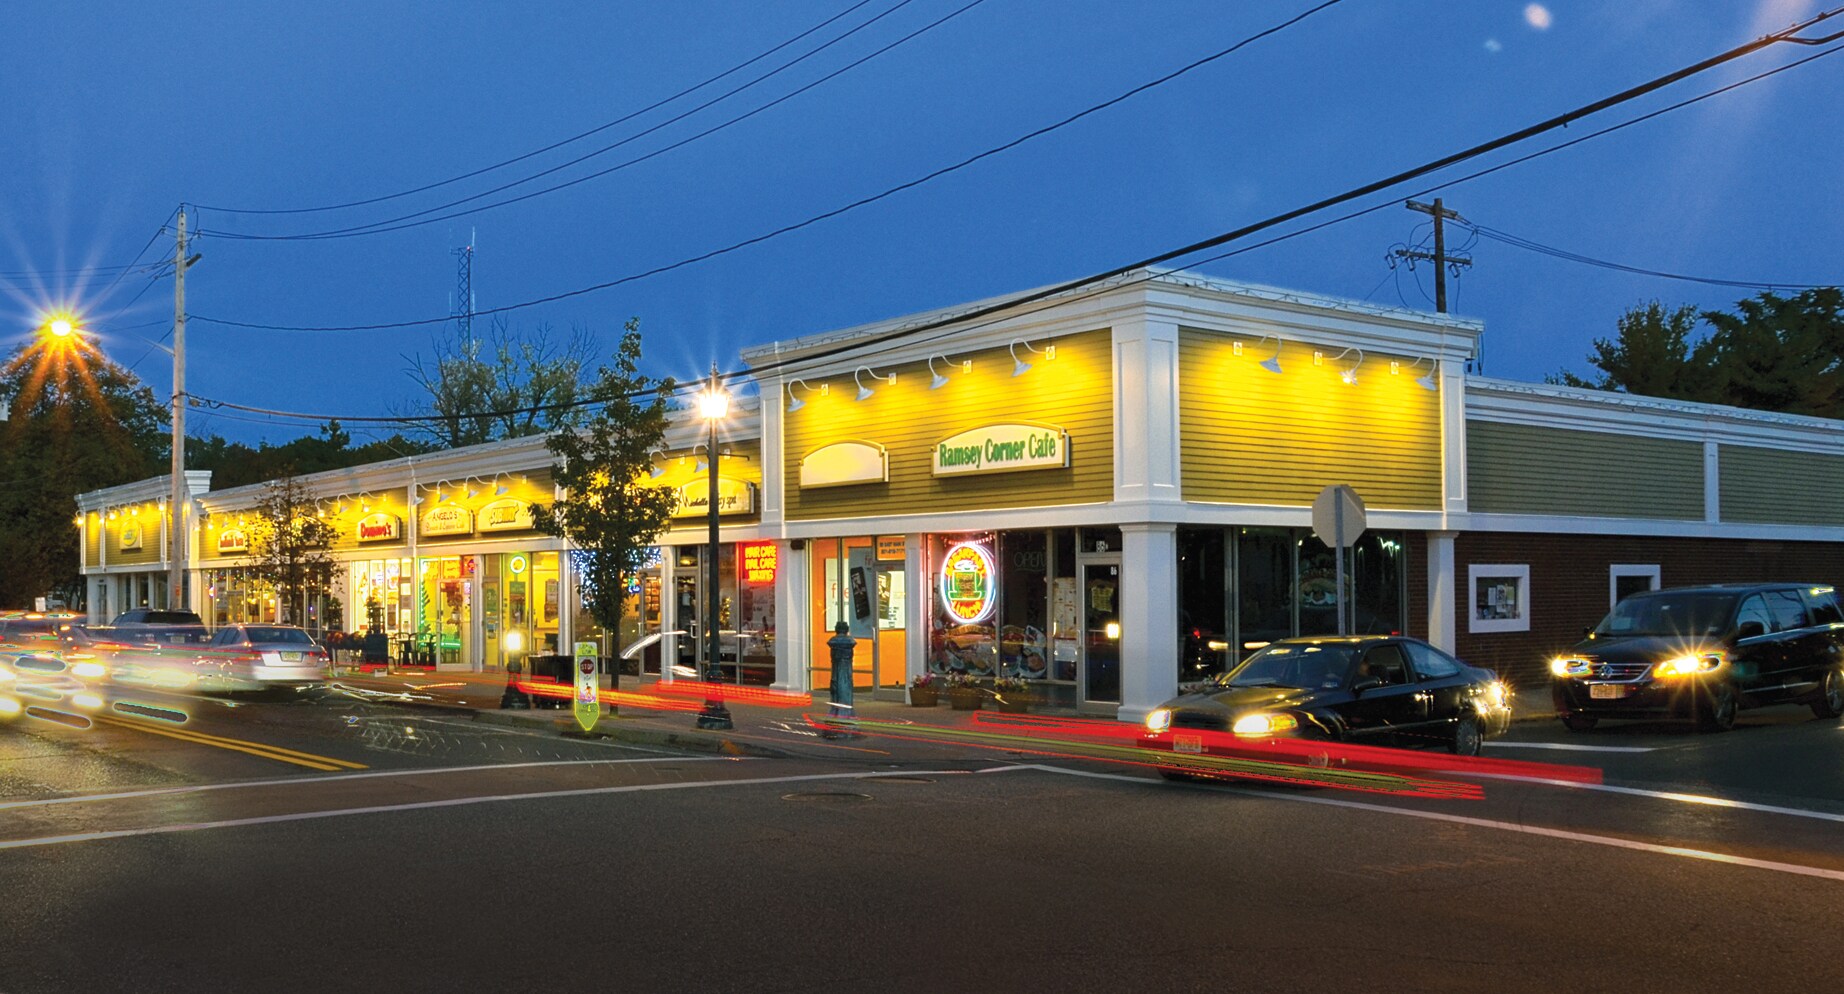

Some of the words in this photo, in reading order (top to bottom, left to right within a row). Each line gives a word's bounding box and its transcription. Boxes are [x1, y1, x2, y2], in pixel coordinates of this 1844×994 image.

[940, 444, 982, 469] Ramsey
[985, 438, 1025, 462] Corner
[1028, 432, 1056, 458] Cafe
[745, 546, 760, 558] HAIR
[760, 545, 776, 557] CARE
[745, 558, 760, 569] NAIL
[760, 557, 776, 569] CARE
[951, 600, 982, 619] LUNCH
